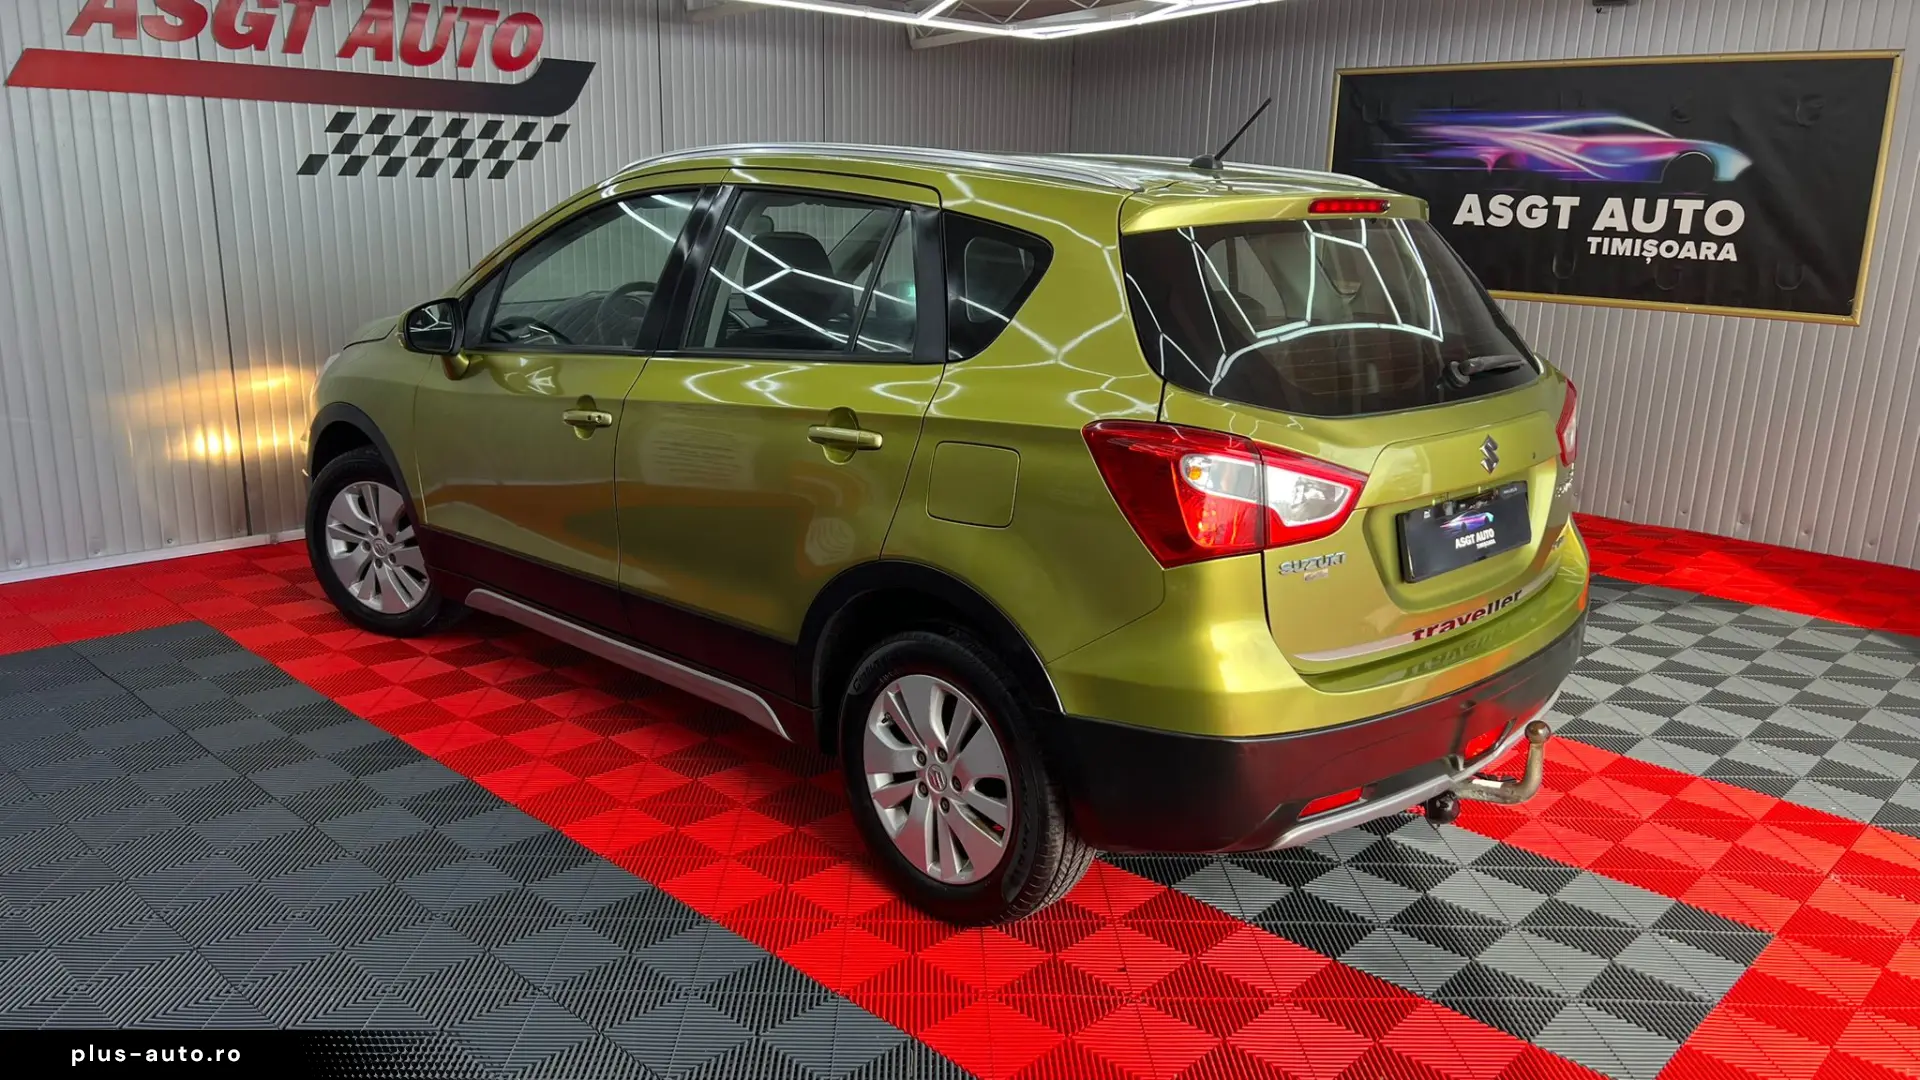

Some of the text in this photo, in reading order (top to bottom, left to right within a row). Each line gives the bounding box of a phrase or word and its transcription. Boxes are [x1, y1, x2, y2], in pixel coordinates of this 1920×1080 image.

[66, 0, 544, 72] ASGT AUTO
[1452, 193, 1745, 236] ASGT AUTO
[1587, 236, 1738, 264] TIMIȘOARA
[1455, 533, 1476, 549] ASGT
[1475, 528, 1495, 542] AUTO
[1278, 552, 1347, 575] SUZUKI
[1412, 590, 1522, 641] traveller
